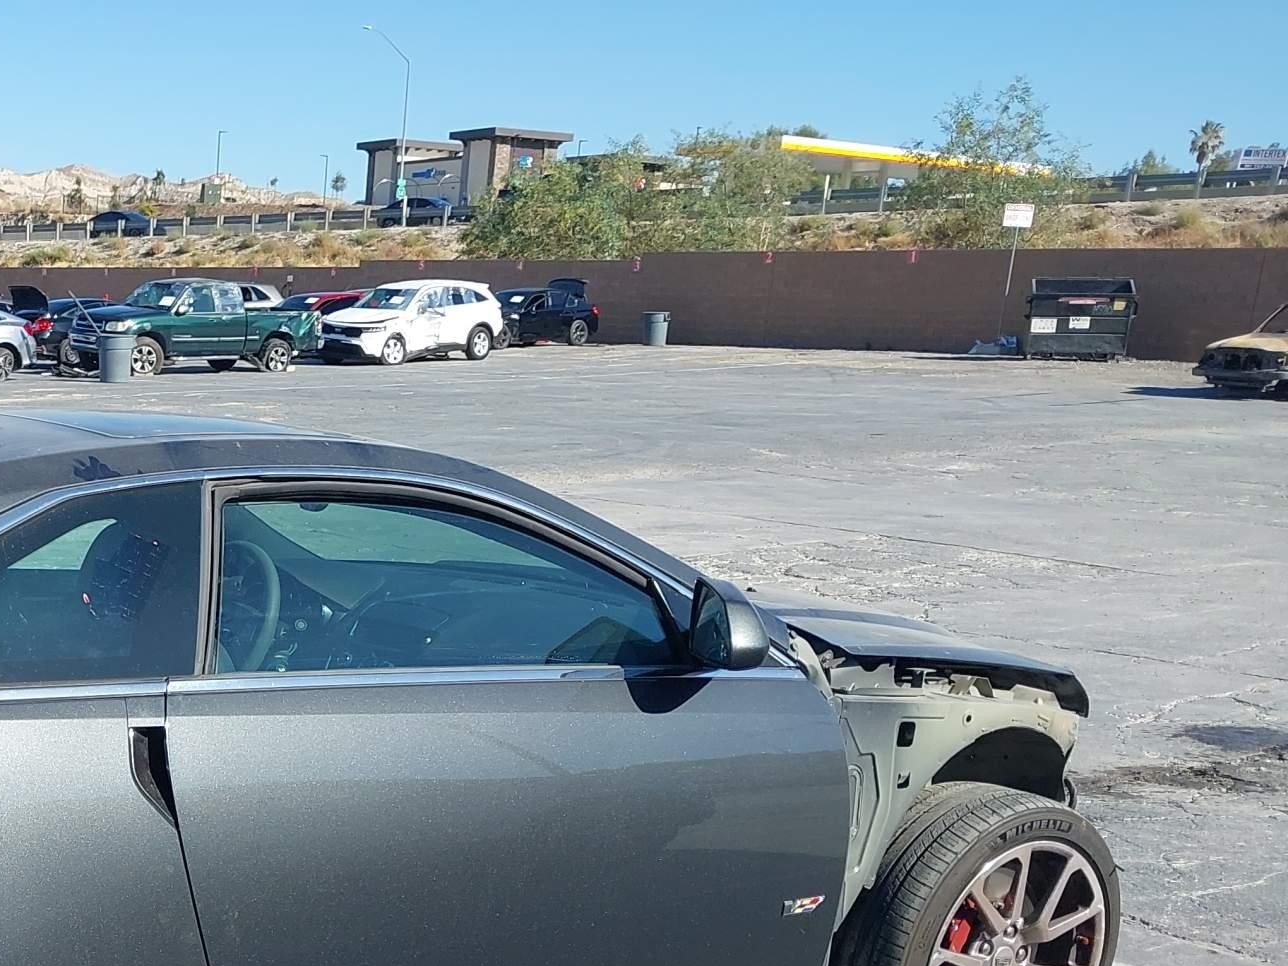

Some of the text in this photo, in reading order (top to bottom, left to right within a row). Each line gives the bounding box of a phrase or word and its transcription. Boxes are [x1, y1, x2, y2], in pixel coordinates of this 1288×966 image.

[765, 252, 773, 264] 2
[910, 251, 917, 264] 1
[1006, 819, 1072, 839] MICHELIN
